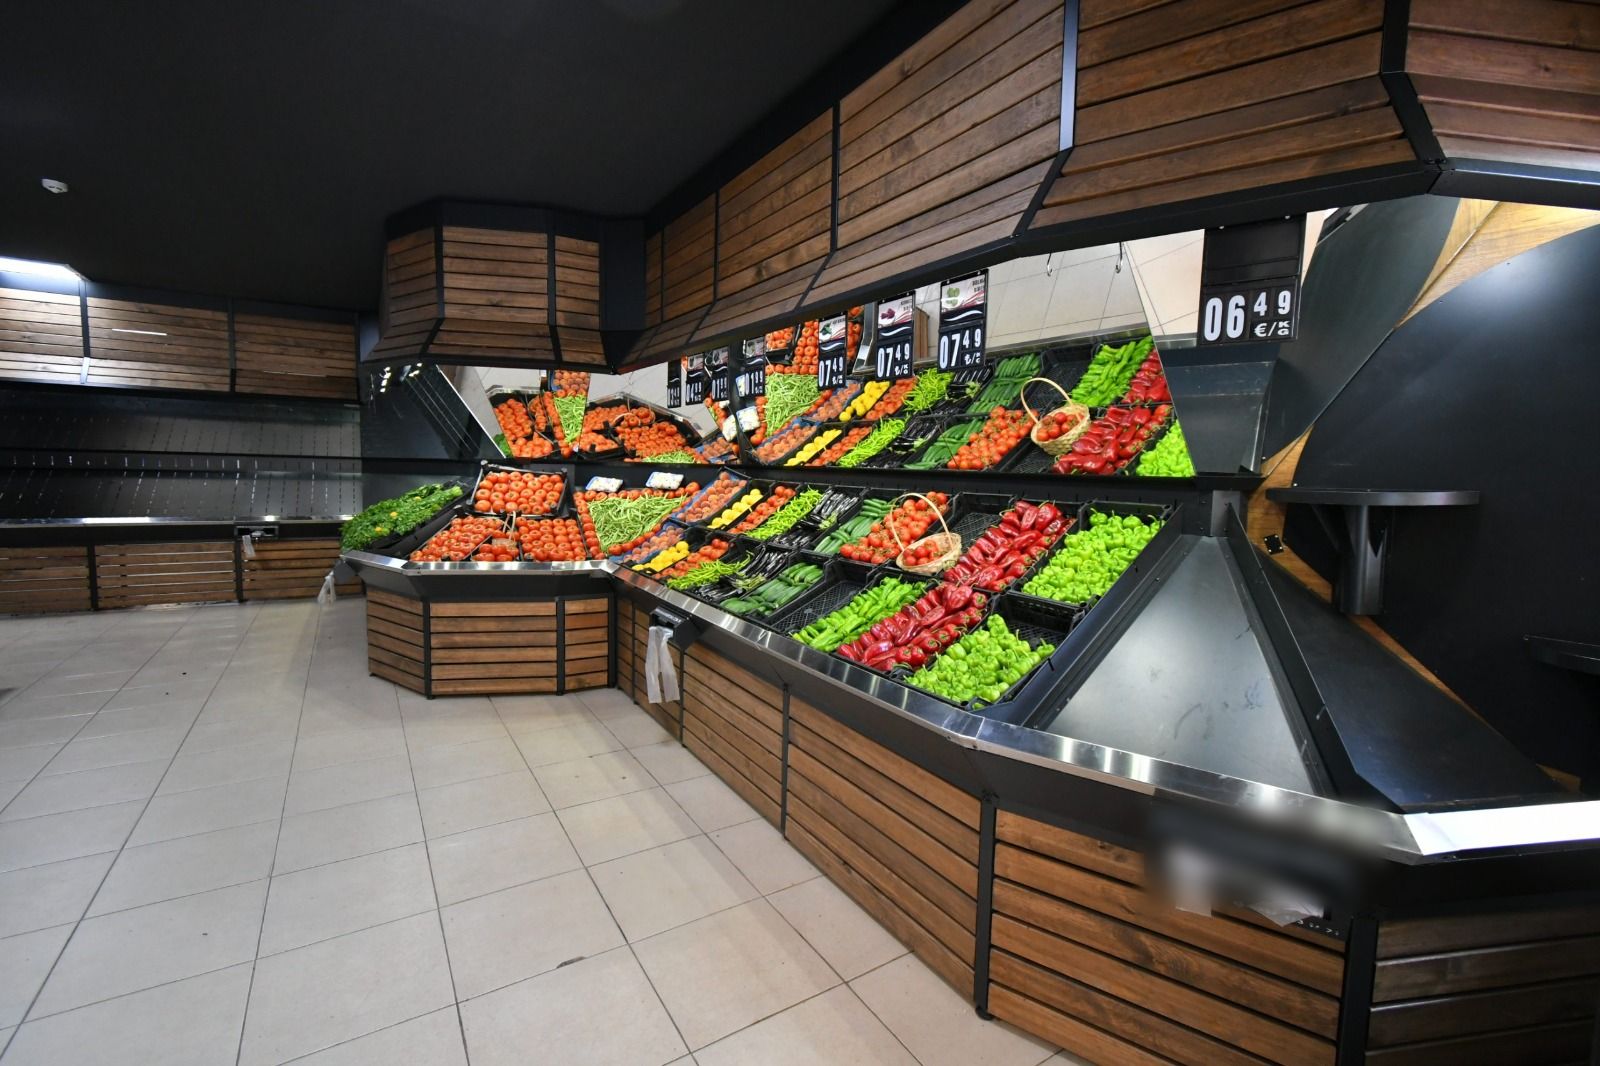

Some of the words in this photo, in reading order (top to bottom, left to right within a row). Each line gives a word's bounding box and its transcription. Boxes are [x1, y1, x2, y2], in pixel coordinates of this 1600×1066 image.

[1204, 294, 1245, 342] 06
[1253, 290, 1291, 317] 49
[877, 347, 893, 378] 07
[895, 343, 910, 361] 49
[939, 333, 961, 369] 07
[963, 328, 981, 349] 49
[818, 359, 831, 387] 07
[832, 356, 844, 372] 49
